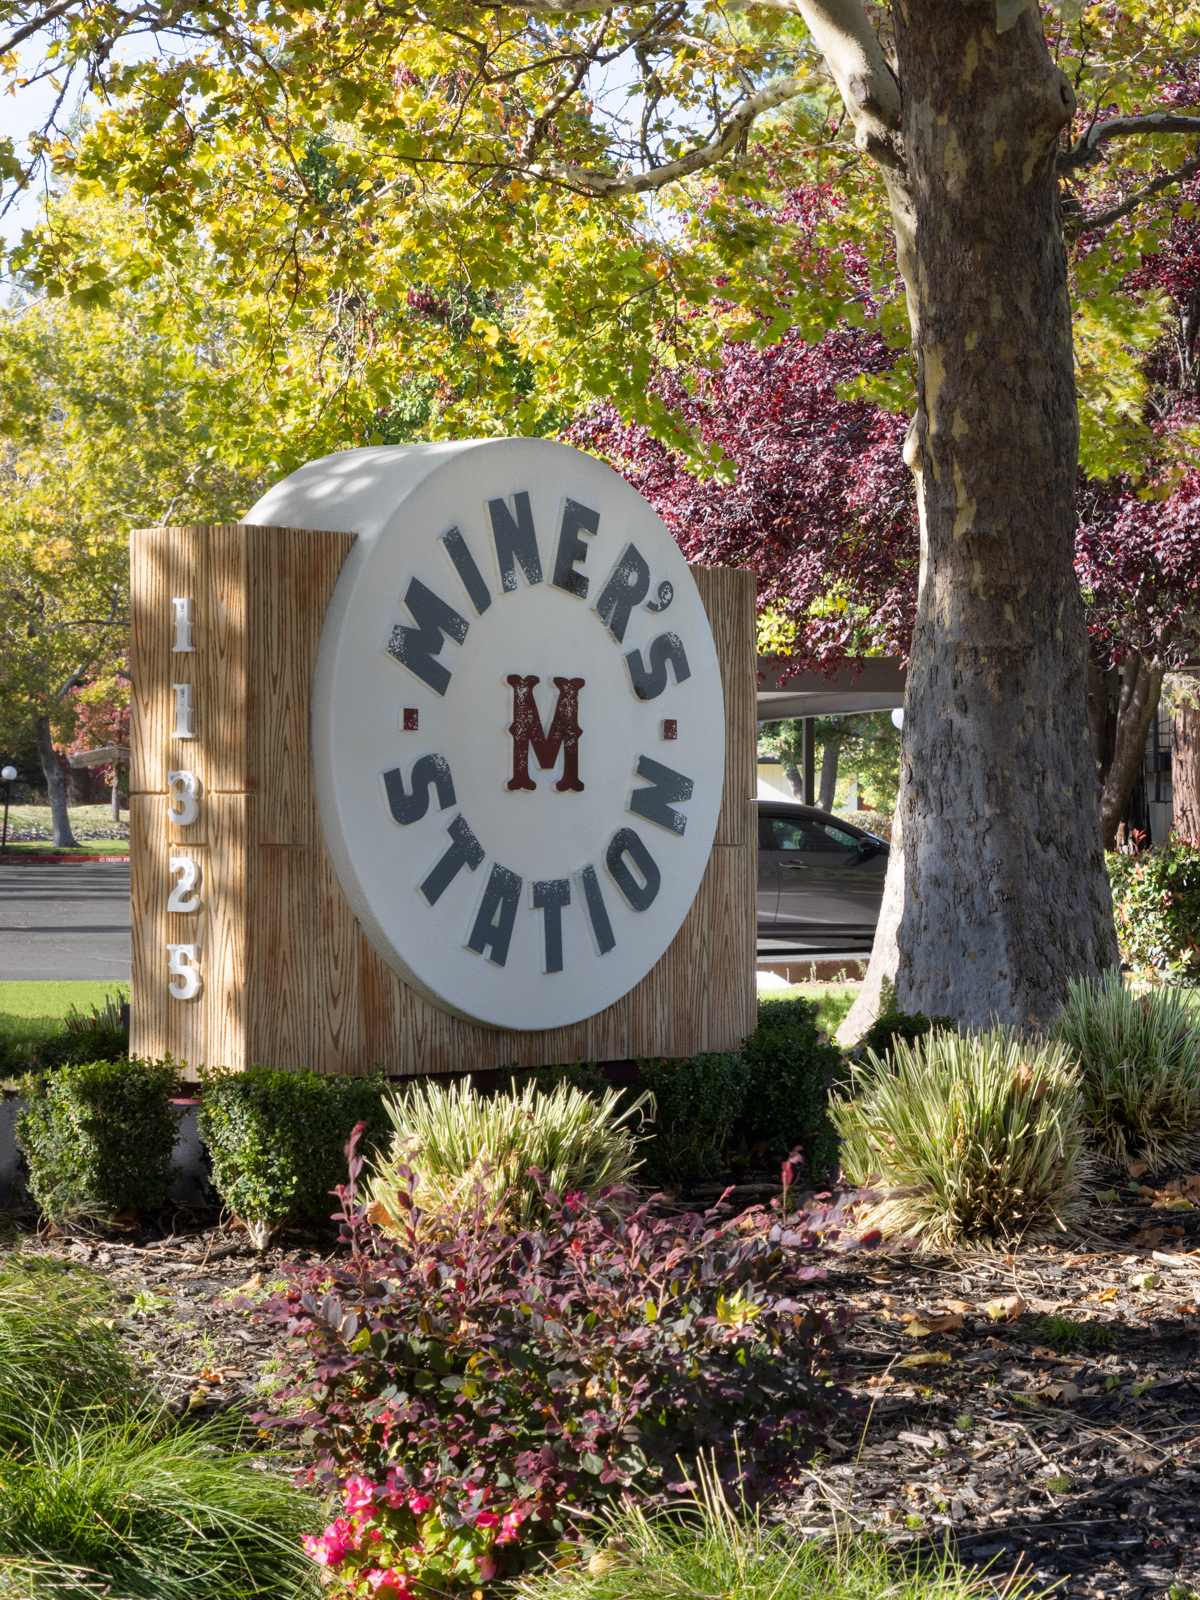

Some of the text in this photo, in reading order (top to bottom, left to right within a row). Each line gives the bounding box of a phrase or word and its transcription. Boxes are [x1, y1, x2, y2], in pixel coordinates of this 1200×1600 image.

[382, 491, 692, 701] MINER'S
[503, 674, 585, 791] M
[379, 753, 694, 973] STATION
